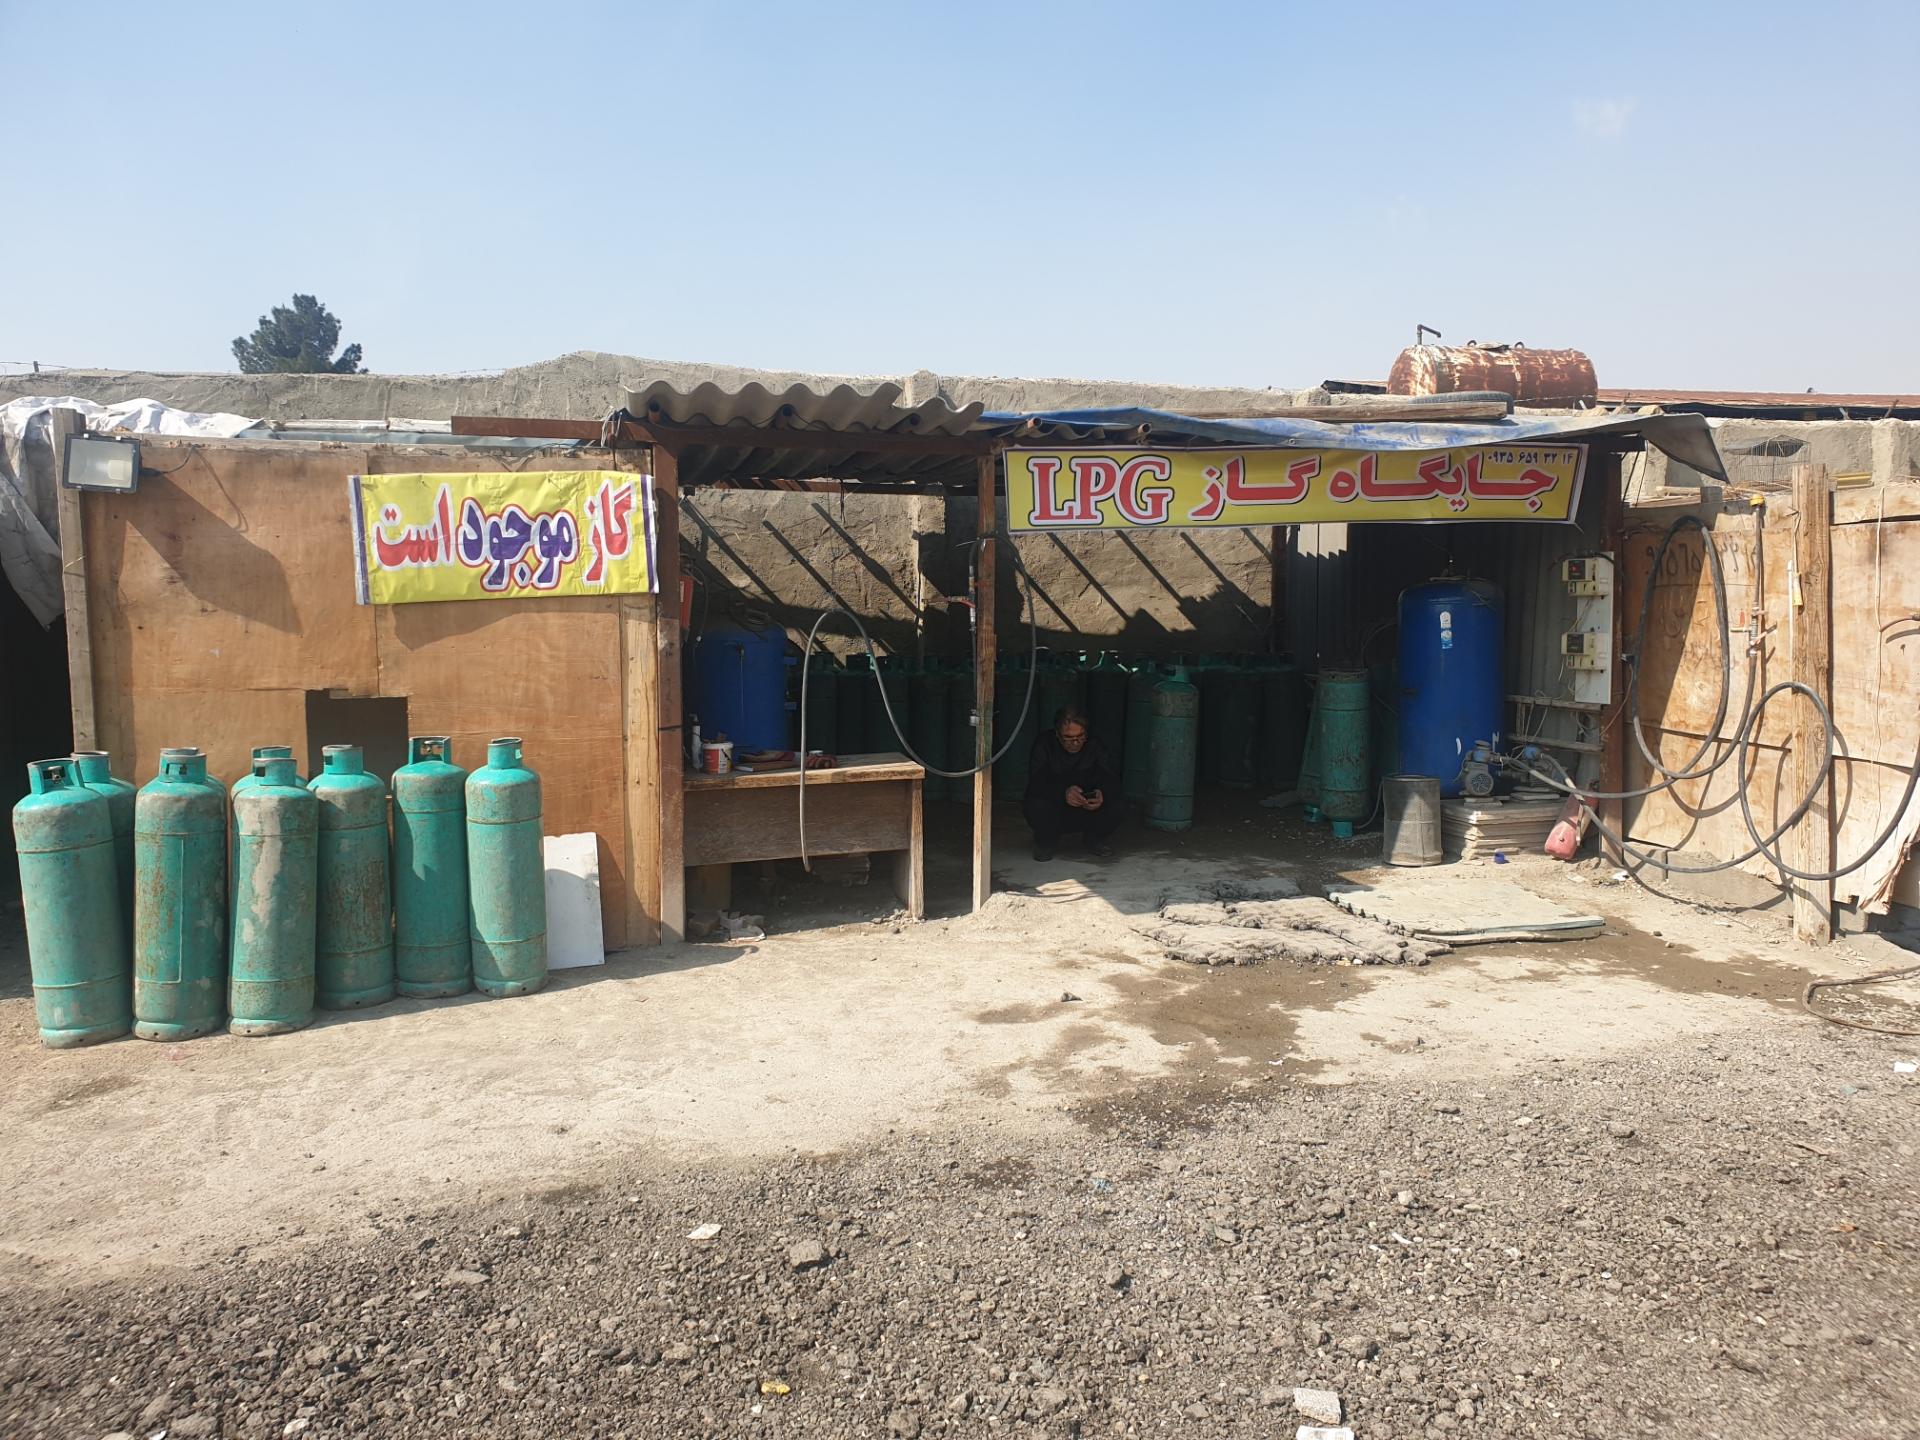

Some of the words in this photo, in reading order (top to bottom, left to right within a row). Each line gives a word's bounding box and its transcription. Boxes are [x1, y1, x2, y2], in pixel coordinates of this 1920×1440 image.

[1029, 456, 1173, 524] LPG
[1190, 455, 1320, 521] گاز
[1329, 451, 1558, 512] جایگاه
[1488, 450, 1514, 464] ۰۹۳۵
[1518, 451, 1539, 465] ۶۵۹
[374, 484, 454, 569] است
[459, 500, 577, 589] موجود
[584, 481, 634, 583] گاز
